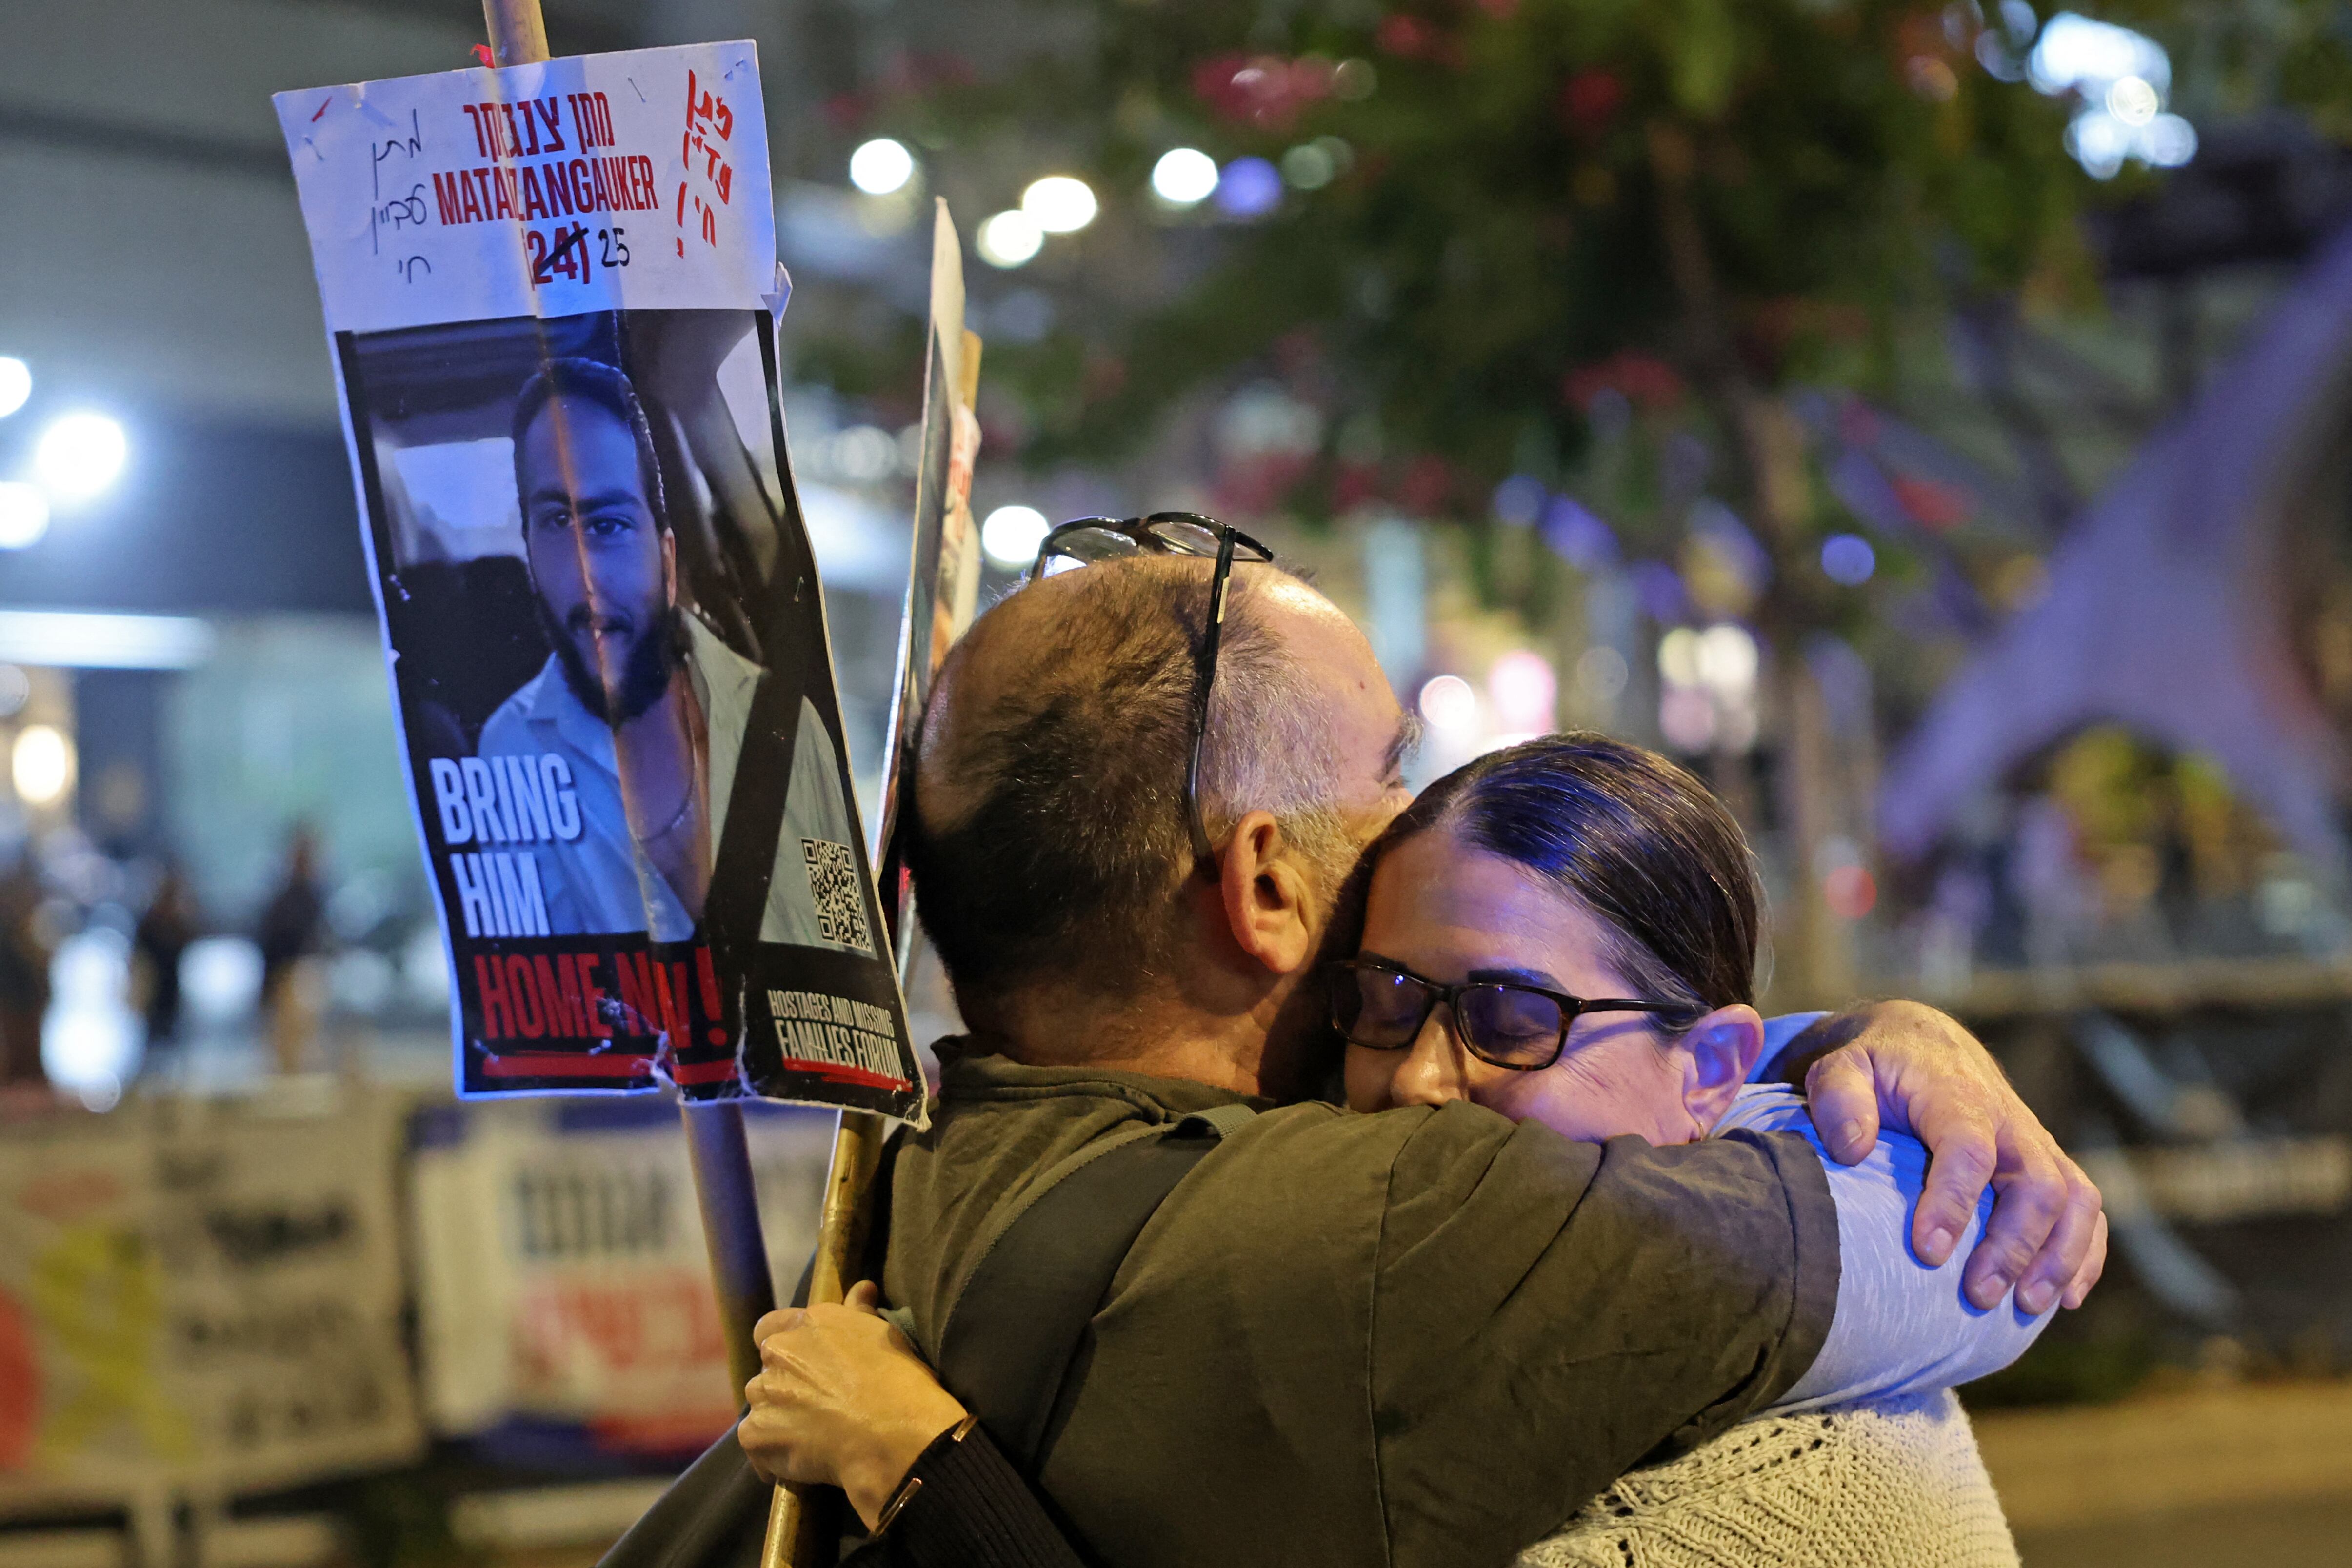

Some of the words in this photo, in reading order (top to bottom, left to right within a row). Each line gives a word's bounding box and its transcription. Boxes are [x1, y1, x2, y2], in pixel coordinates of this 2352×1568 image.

[372, 108, 422, 201] מתן
[568, 92, 616, 155] מתן
[398, 256, 431, 284] חי
[598, 228, 630, 268] 25
[429, 753, 582, 845] BRING
[449, 852, 552, 938] HIM
[474, 953, 614, 1039] HOME
[767, 989, 832, 1022] HOSTAGES
[831, 996, 854, 1026] AND
[851, 1000, 895, 1038] MISSING
[775, 1019, 856, 1068] FAMILIES
[852, 1029, 907, 1083] FORUM
